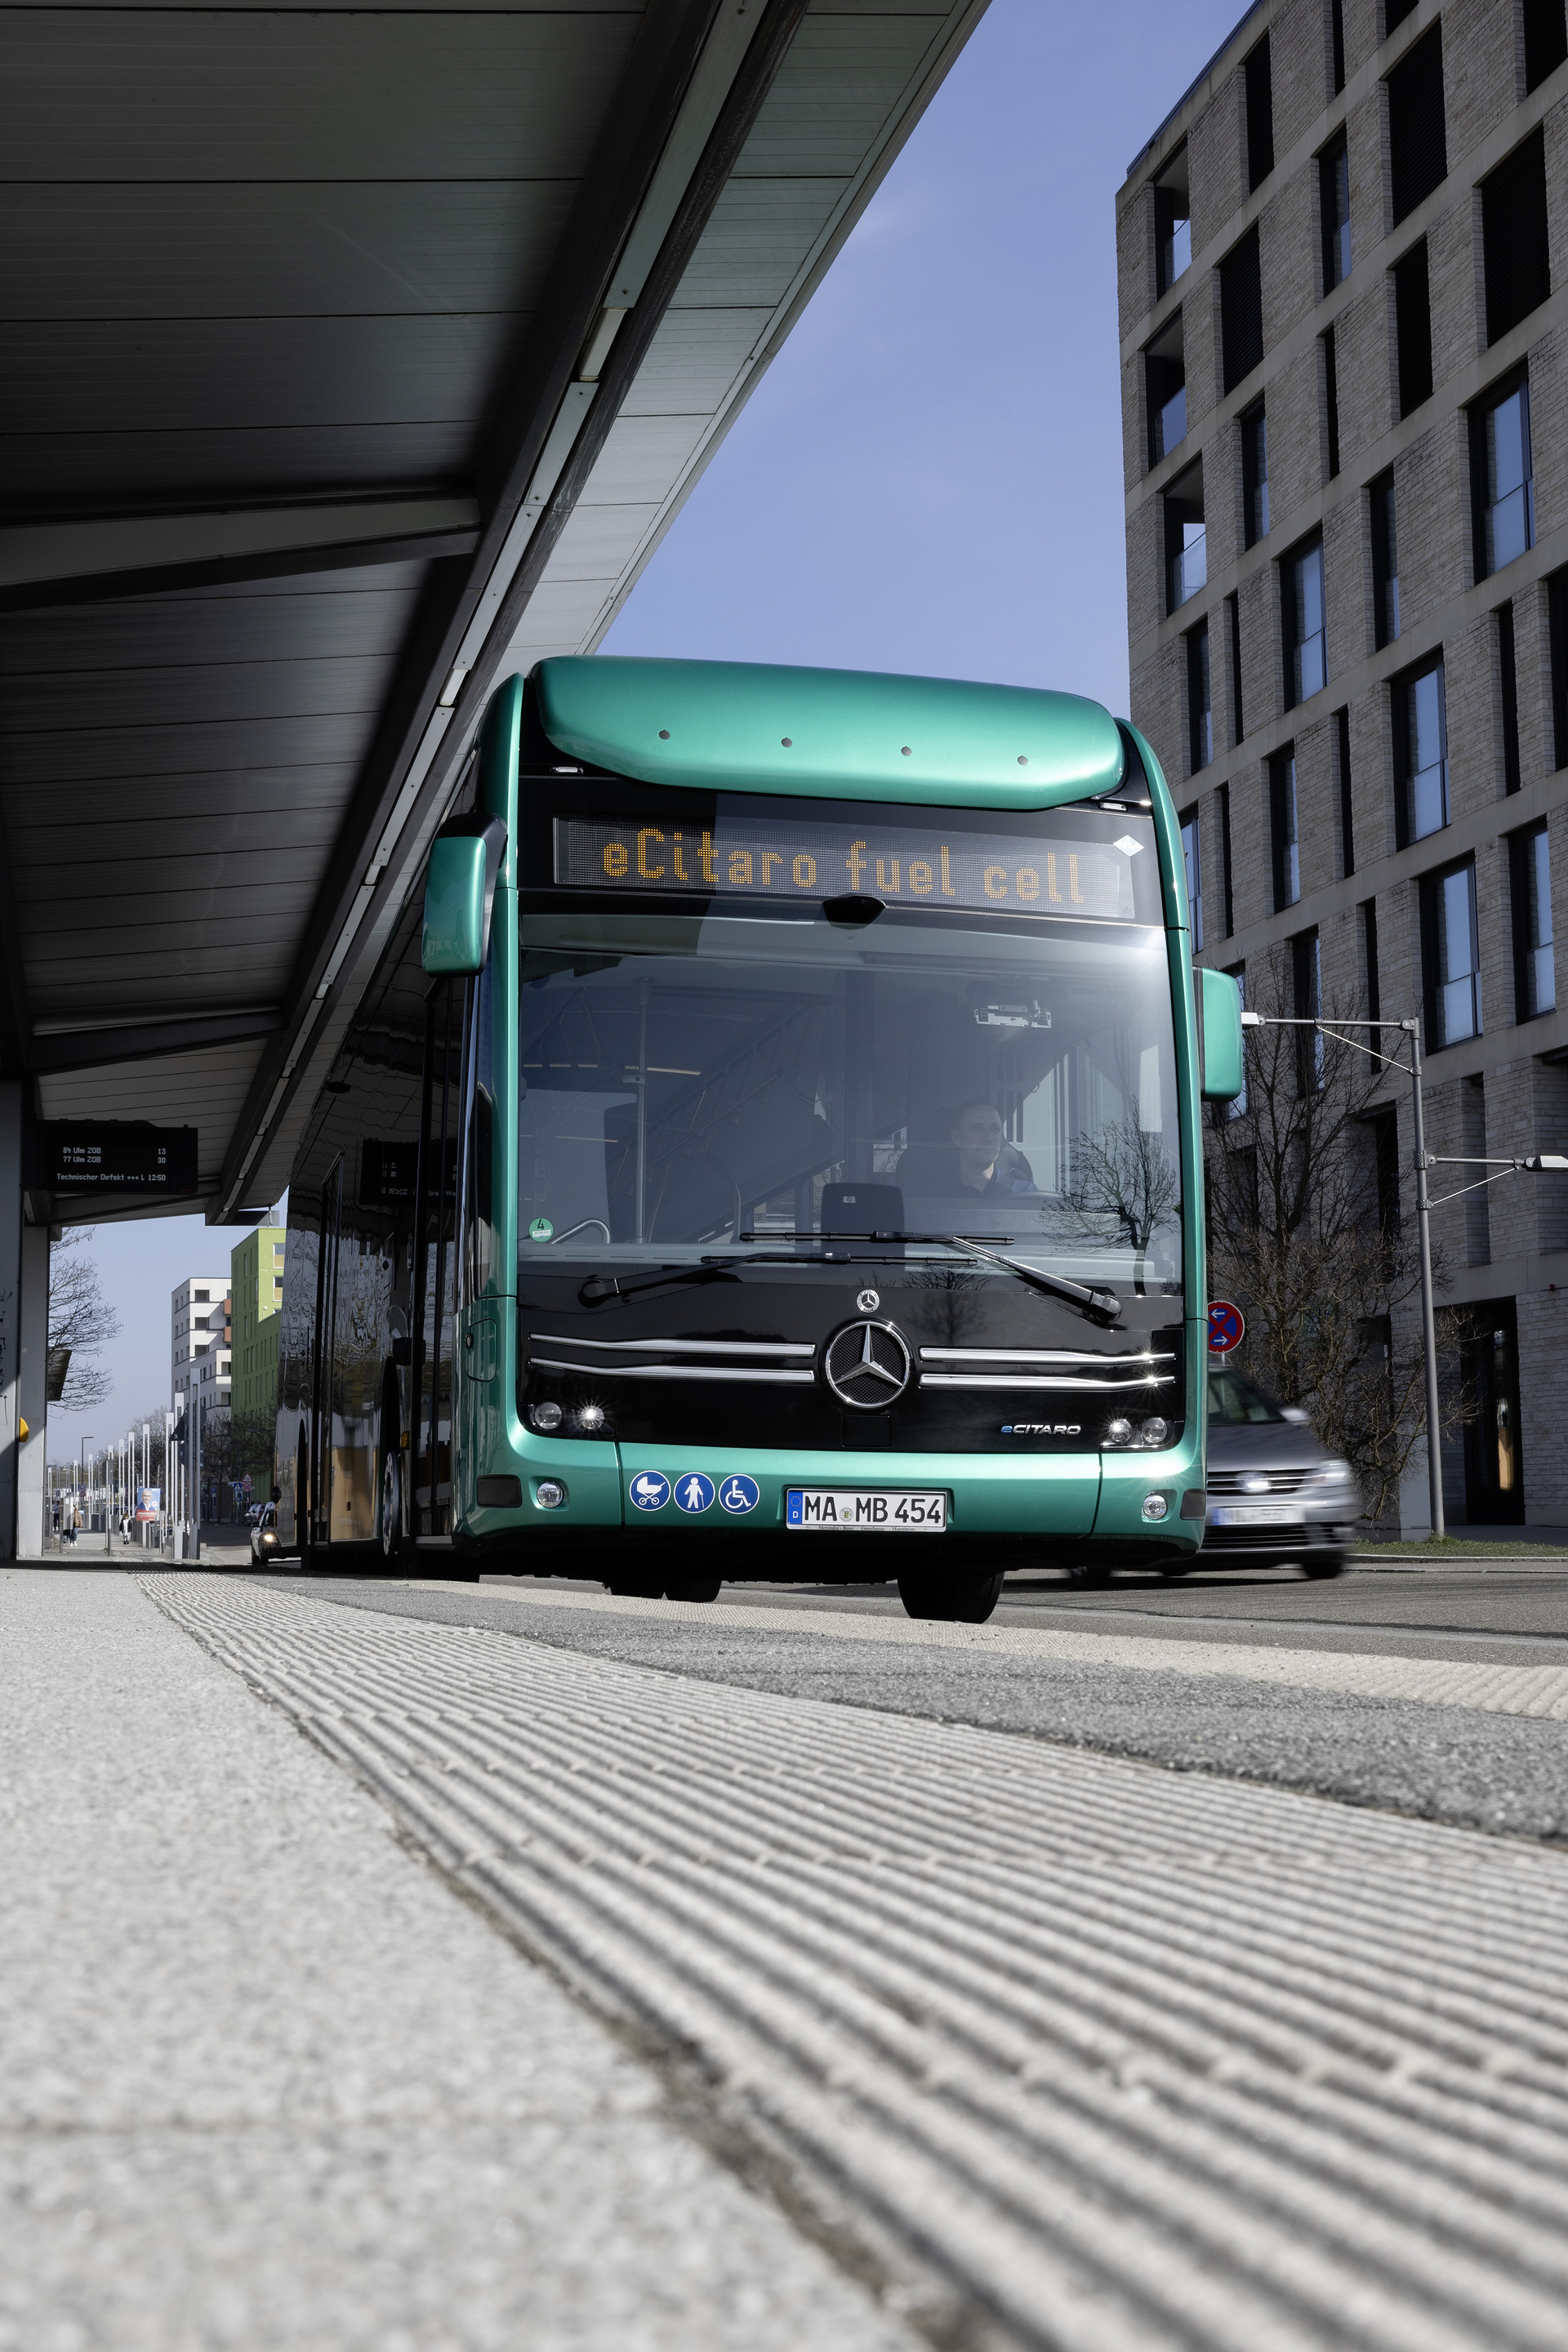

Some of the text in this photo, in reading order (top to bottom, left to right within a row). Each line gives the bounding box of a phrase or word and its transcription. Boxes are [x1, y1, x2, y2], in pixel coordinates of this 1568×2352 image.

[603, 828, 1084, 903] eCitaro fuel cell
[537, 1218, 545, 1230] 4
[1000, 1424, 1081, 1435] eCITARO
[792, 1511, 799, 1519] D
[804, 1495, 942, 1524] MA MB 454
